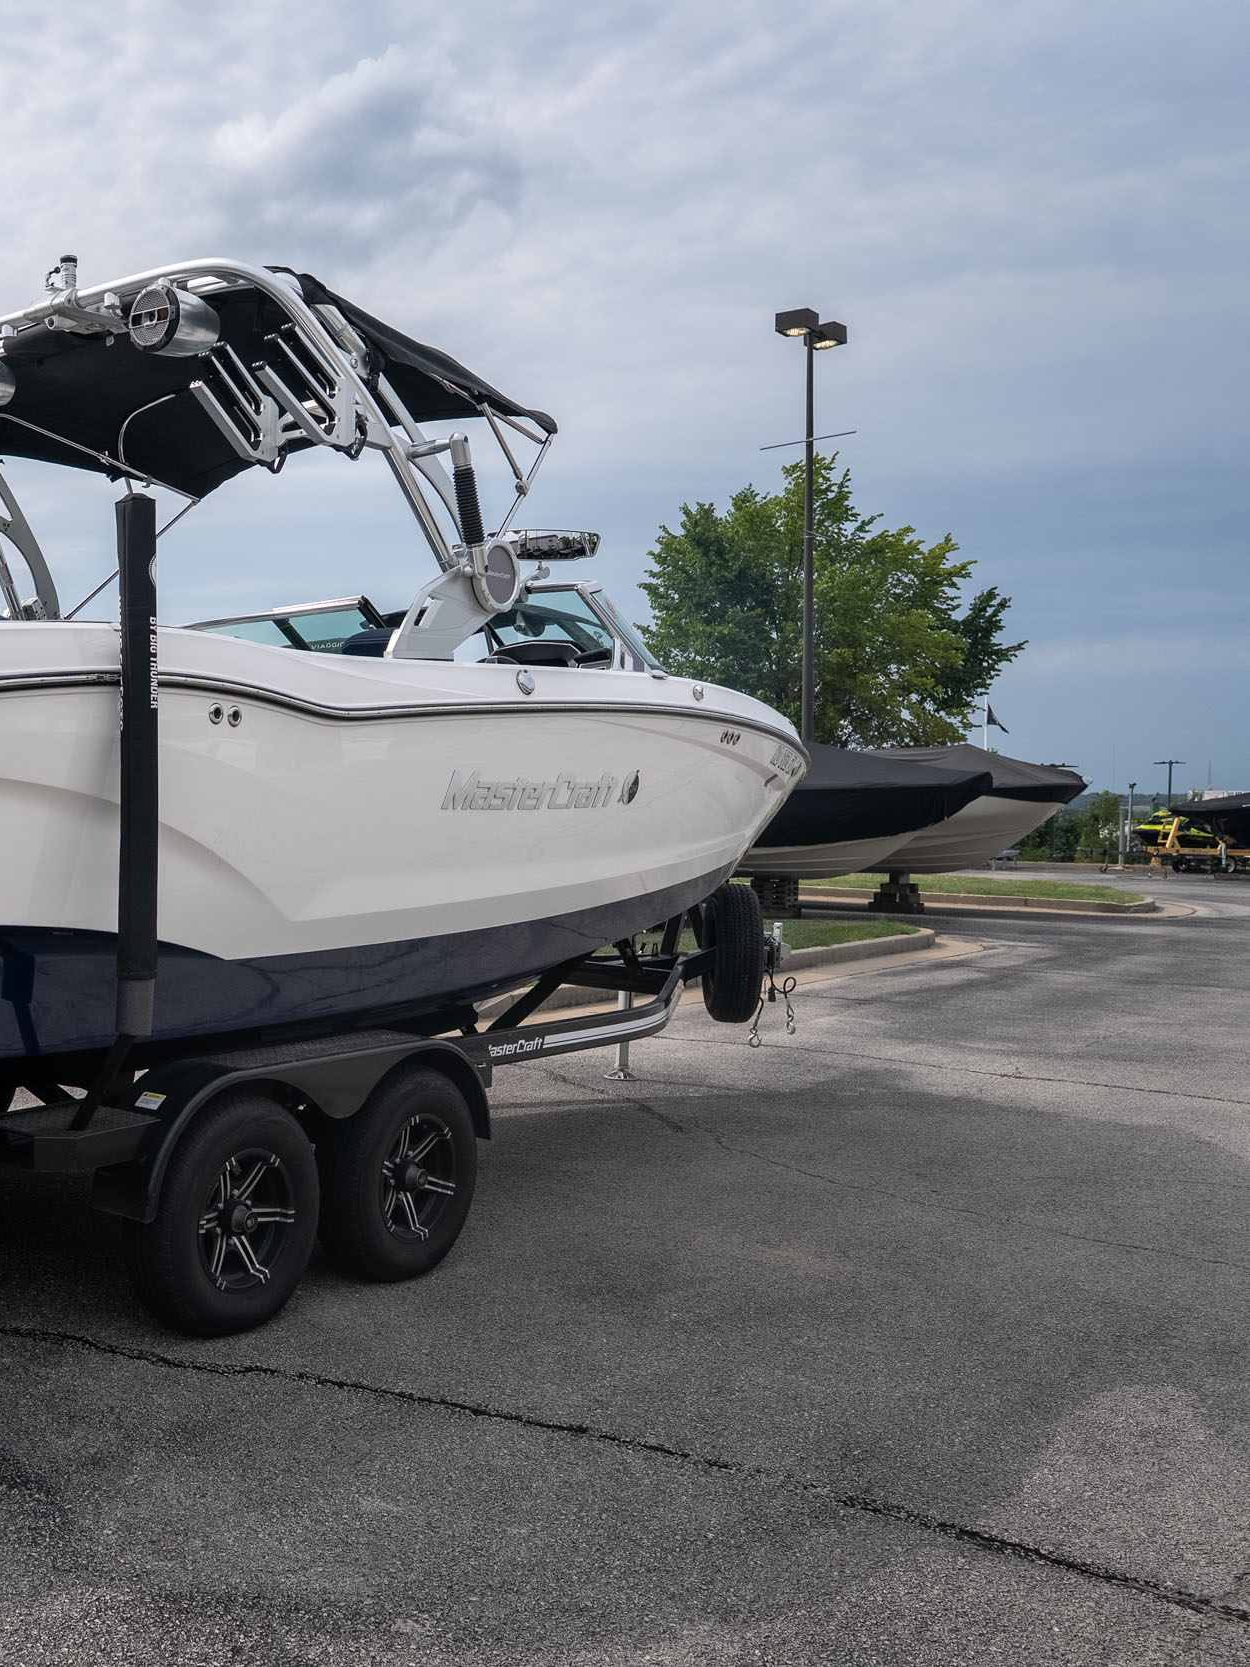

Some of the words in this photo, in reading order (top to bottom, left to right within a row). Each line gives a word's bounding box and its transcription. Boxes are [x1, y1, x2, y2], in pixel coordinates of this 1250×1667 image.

[149, 634, 158, 654] BIG
[149, 656, 159, 709] THUNDER
[440, 769, 618, 811] MasterCraft
[488, 1037, 543, 1057] asterCraft
